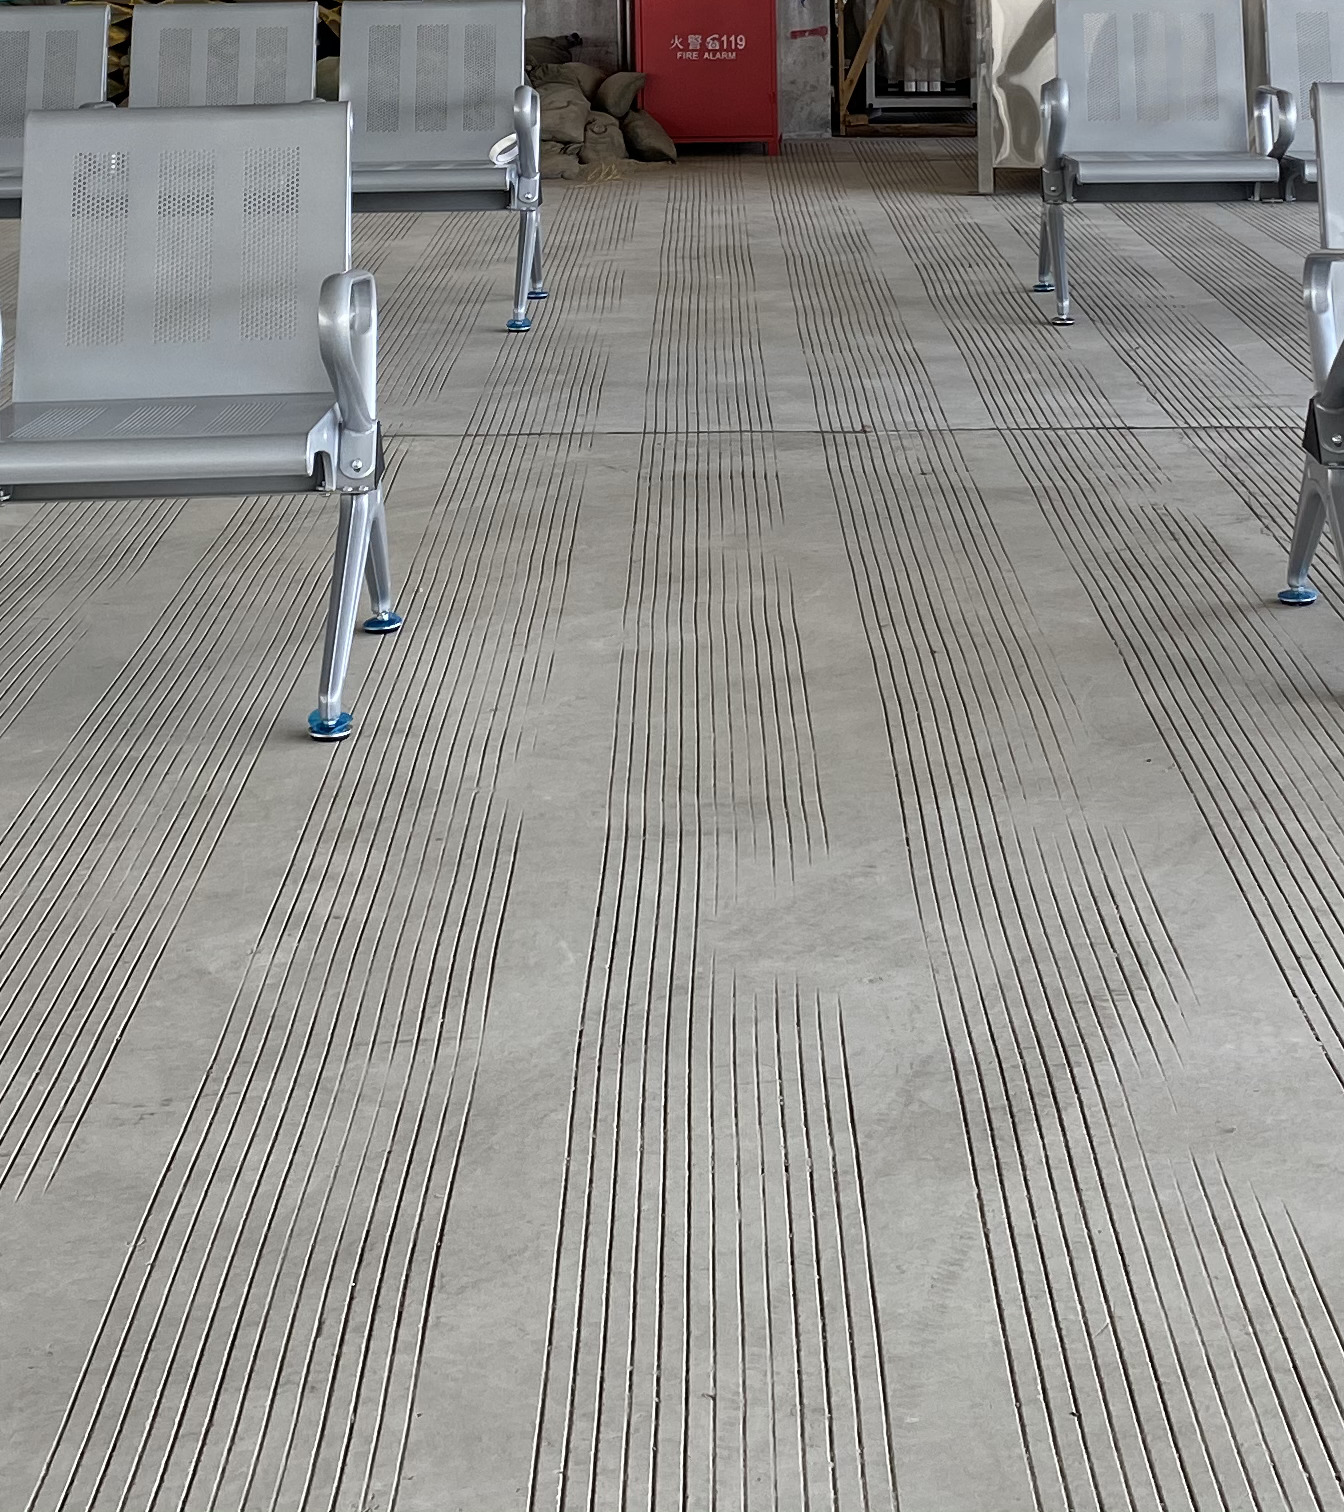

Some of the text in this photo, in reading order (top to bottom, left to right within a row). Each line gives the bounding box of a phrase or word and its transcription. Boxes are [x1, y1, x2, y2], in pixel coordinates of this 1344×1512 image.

[669, 34, 746, 50] 火警 119
[676, 51, 737, 60] FIRE ALARM
